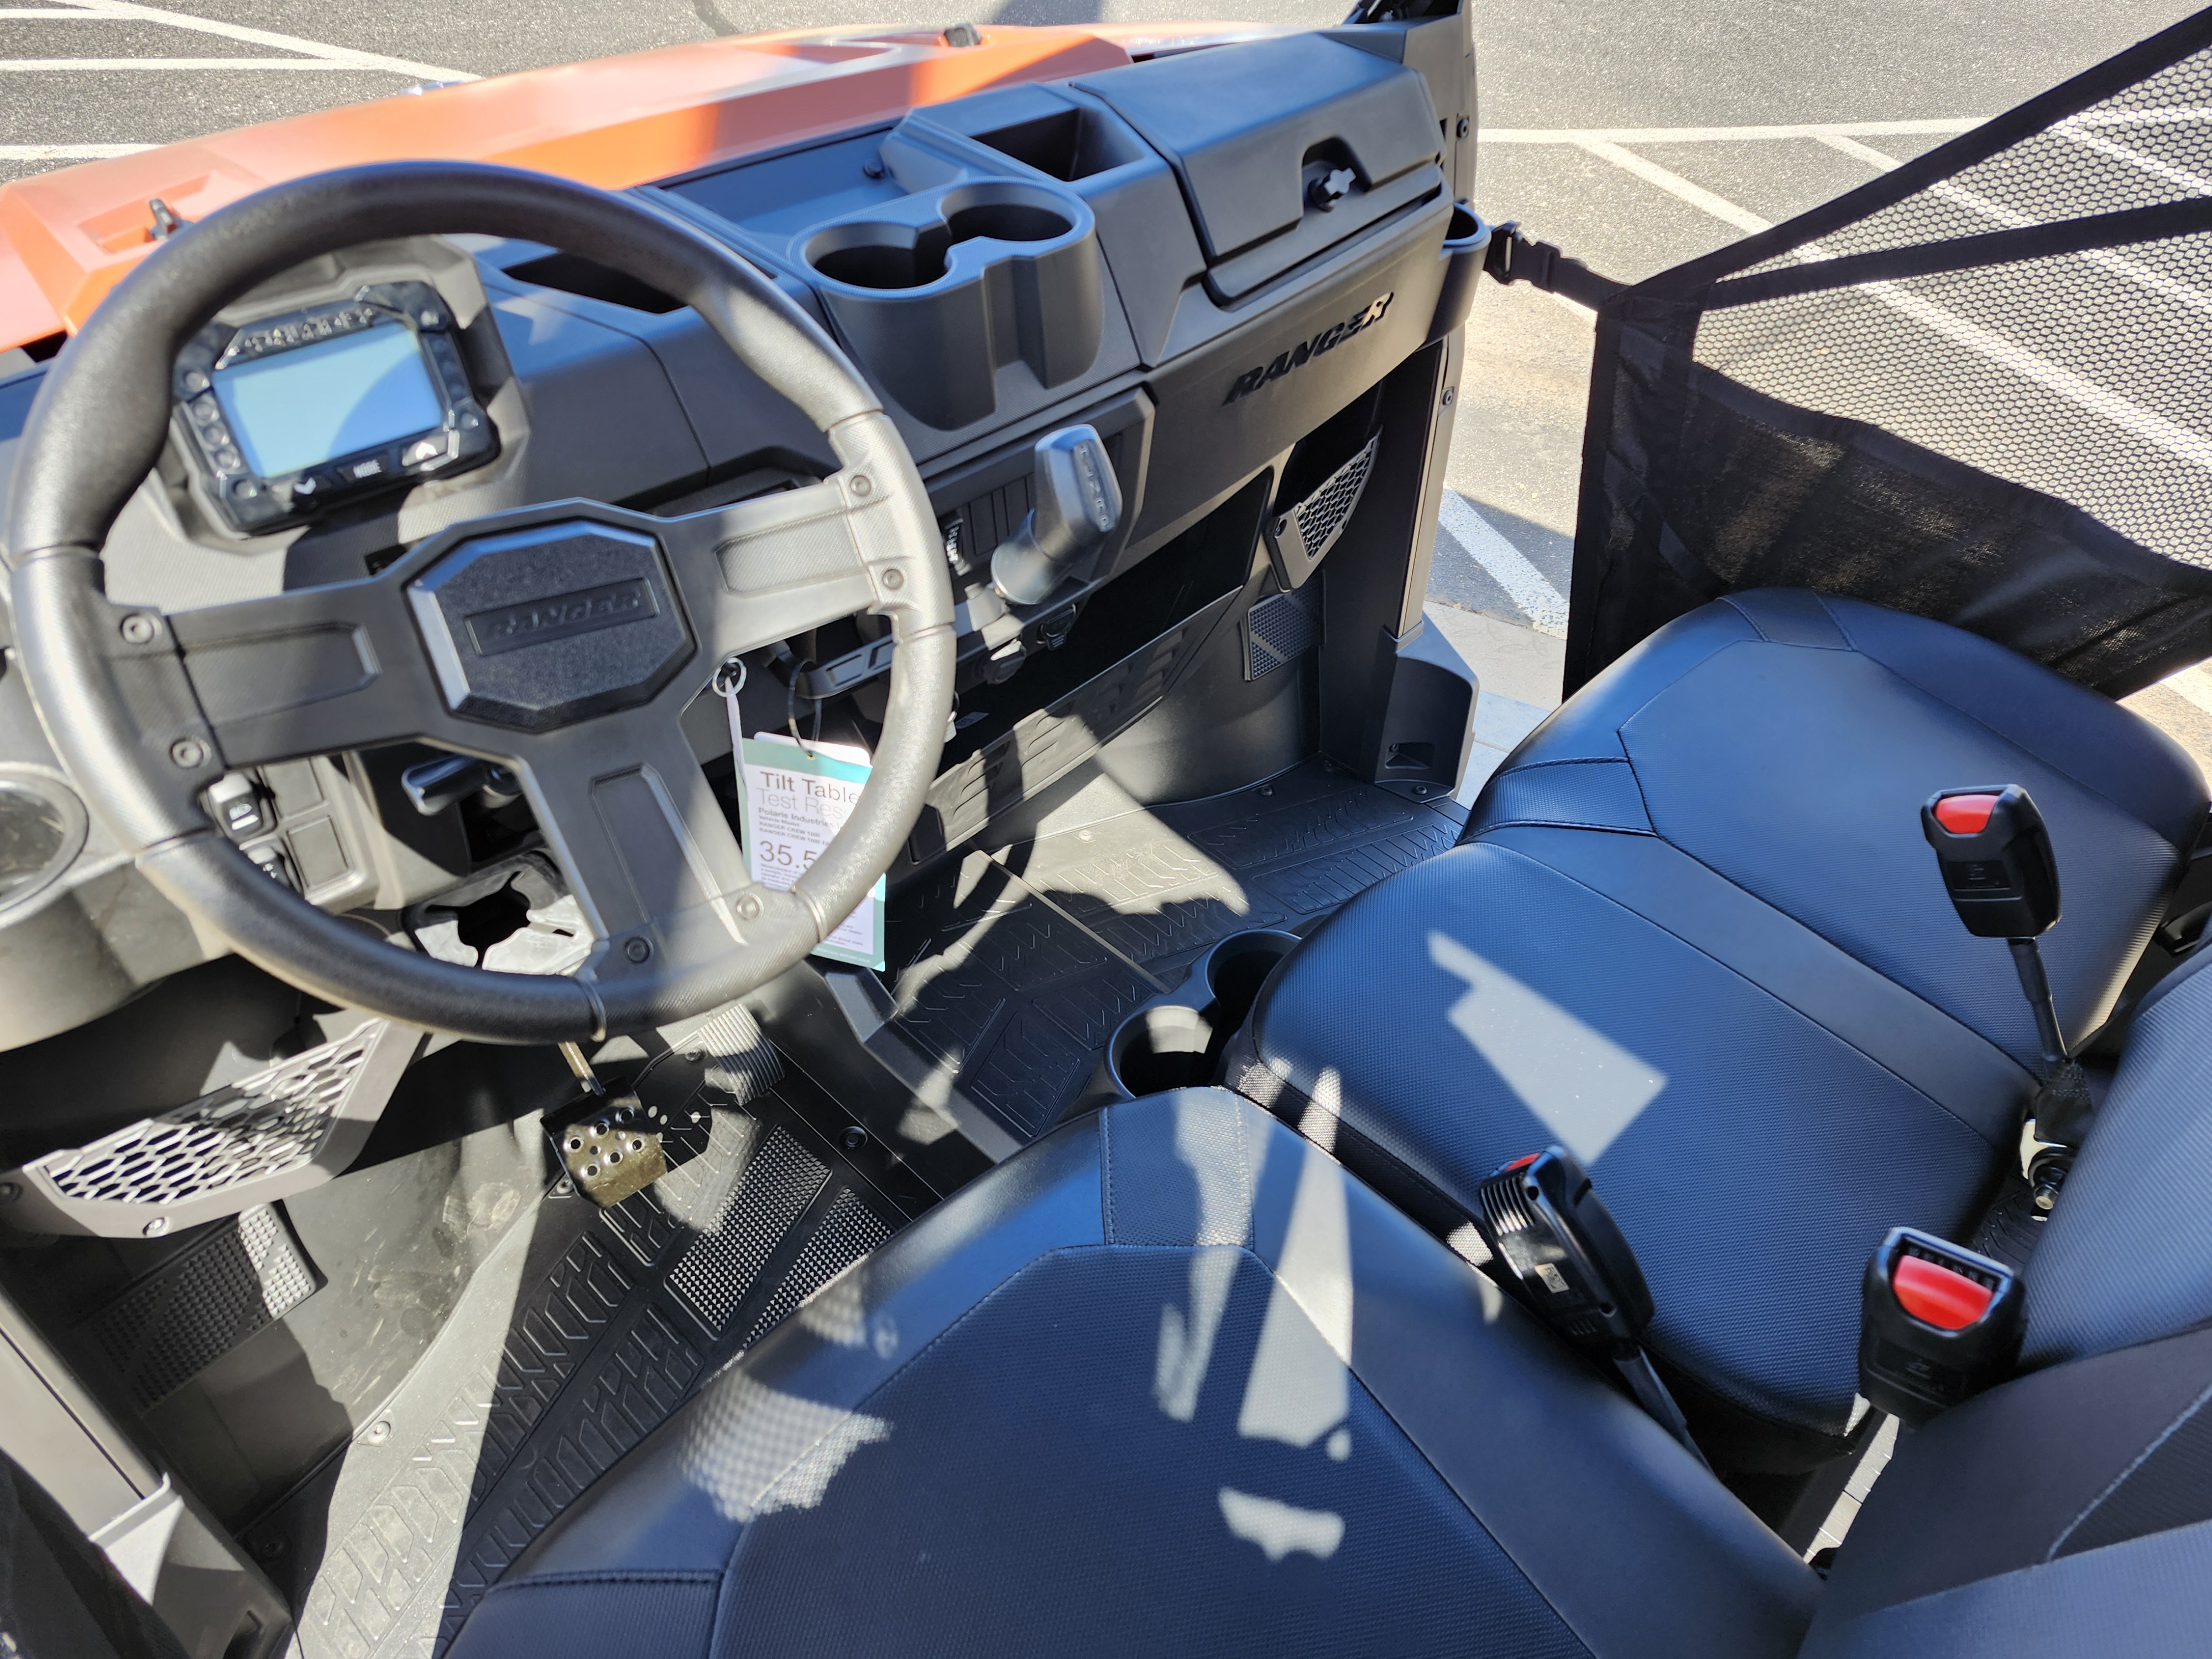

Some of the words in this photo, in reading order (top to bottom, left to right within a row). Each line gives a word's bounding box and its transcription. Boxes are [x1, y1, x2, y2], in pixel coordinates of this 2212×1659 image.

[1221, 291, 1394, 408] RANGER
[353, 459, 382, 479] MODE
[760, 771, 795, 792] Tilt
[802, 778, 859, 805] Table
[757, 787, 798, 811] Test
[758, 807, 789, 819] Polaris
[791, 813, 834, 828] Industries
[759, 815, 780, 823] Vehicle
[759, 821, 786, 830] RANGER
[787, 827, 806, 835] CREW
[760, 827, 786, 837] RANGER
[760, 841, 817, 870] 35.5
